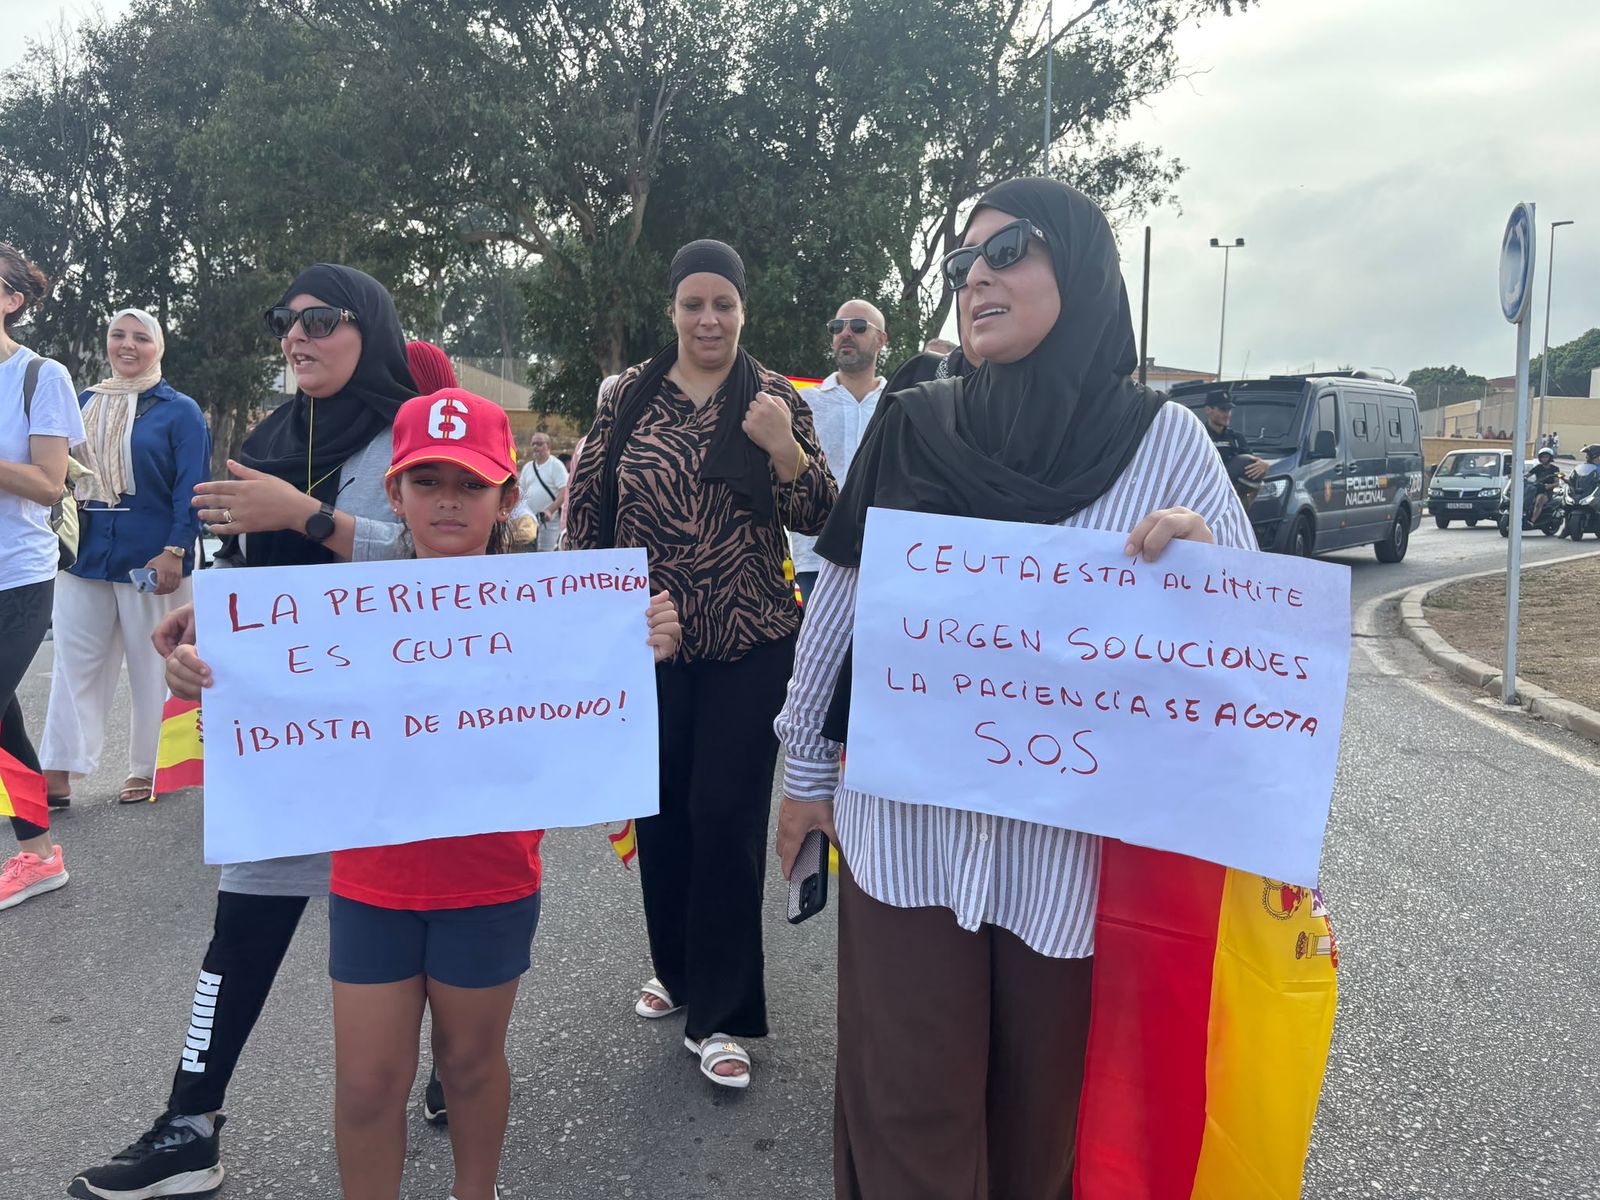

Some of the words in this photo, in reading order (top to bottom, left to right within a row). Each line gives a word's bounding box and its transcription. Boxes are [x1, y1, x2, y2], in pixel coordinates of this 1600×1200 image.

[428, 398, 469, 440] 6
[1345, 490, 1387, 506] NACIONAL
[906, 542, 1041, 584] CEUTA
[1053, 556, 1137, 587] ESTÁ
[1163, 572, 1192, 590] AL
[228, 592, 299, 633] LA
[287, 644, 351, 674] ES
[392, 631, 513, 664] CEUTA
[903, 616, 1041, 653] URGEN
[234, 718, 371, 757] ¡BASTA
[404, 714, 440, 738] DE
[457, 690, 626, 730] ABANDONO!
[887, 666, 927, 695] LA
[1165, 698, 1201, 723] SE
[1214, 702, 1318, 738] AGOTA
[181, 969, 223, 1073] PUMA
